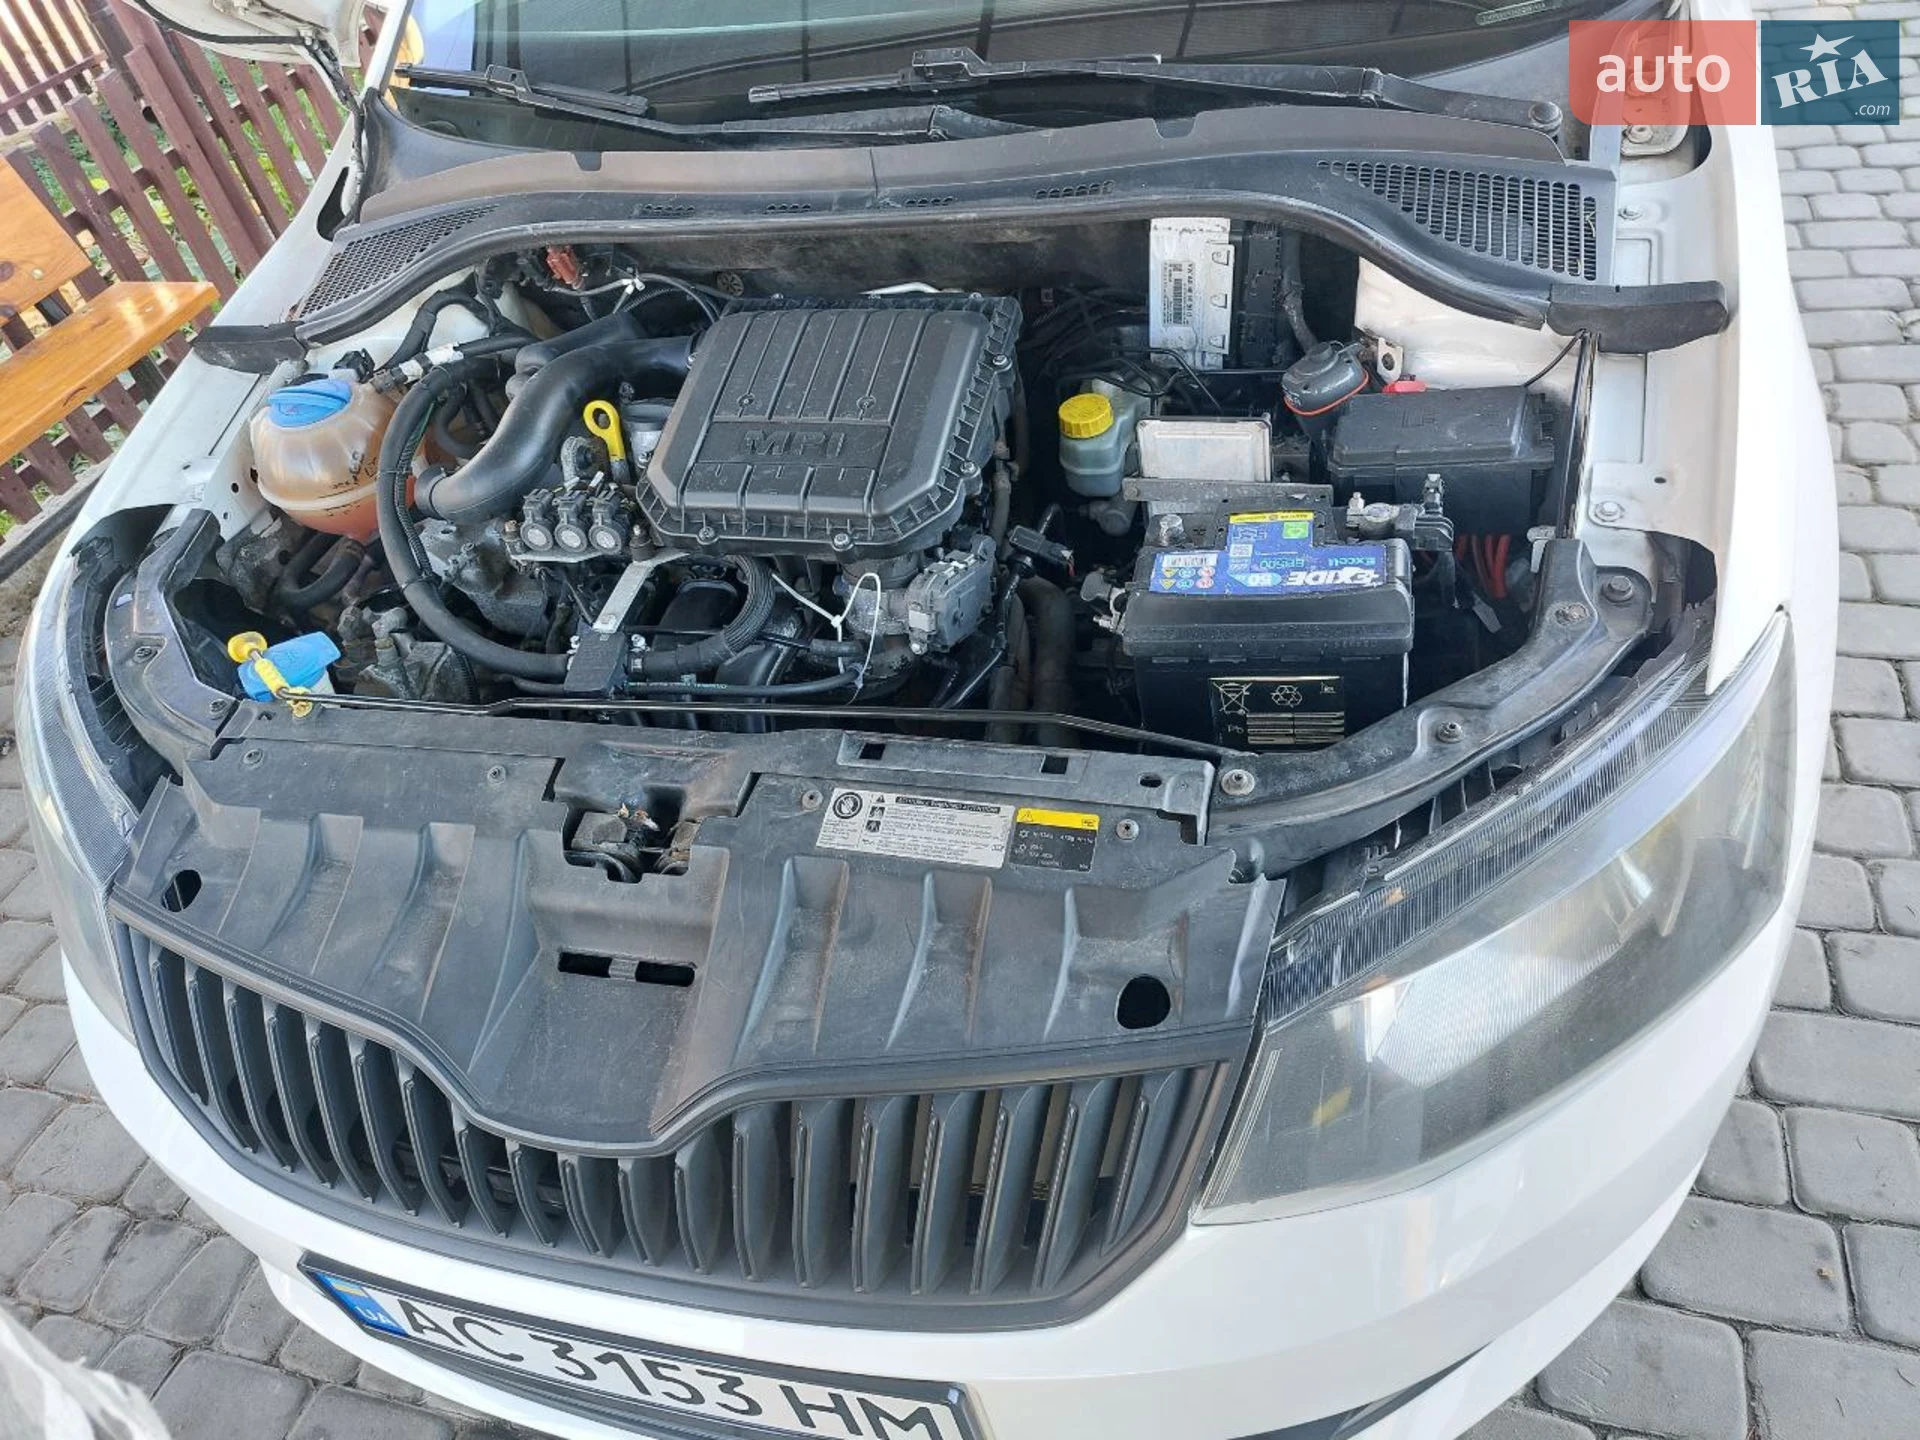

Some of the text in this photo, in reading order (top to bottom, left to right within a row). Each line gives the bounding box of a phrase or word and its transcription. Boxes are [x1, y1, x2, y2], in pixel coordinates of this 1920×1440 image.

[743, 430, 847, 458] MPI
[1286, 567, 1381, 588] EXIDE
[356, 1305, 393, 1325] UA
[397, 1298, 943, 1440] AC 3153 HM
